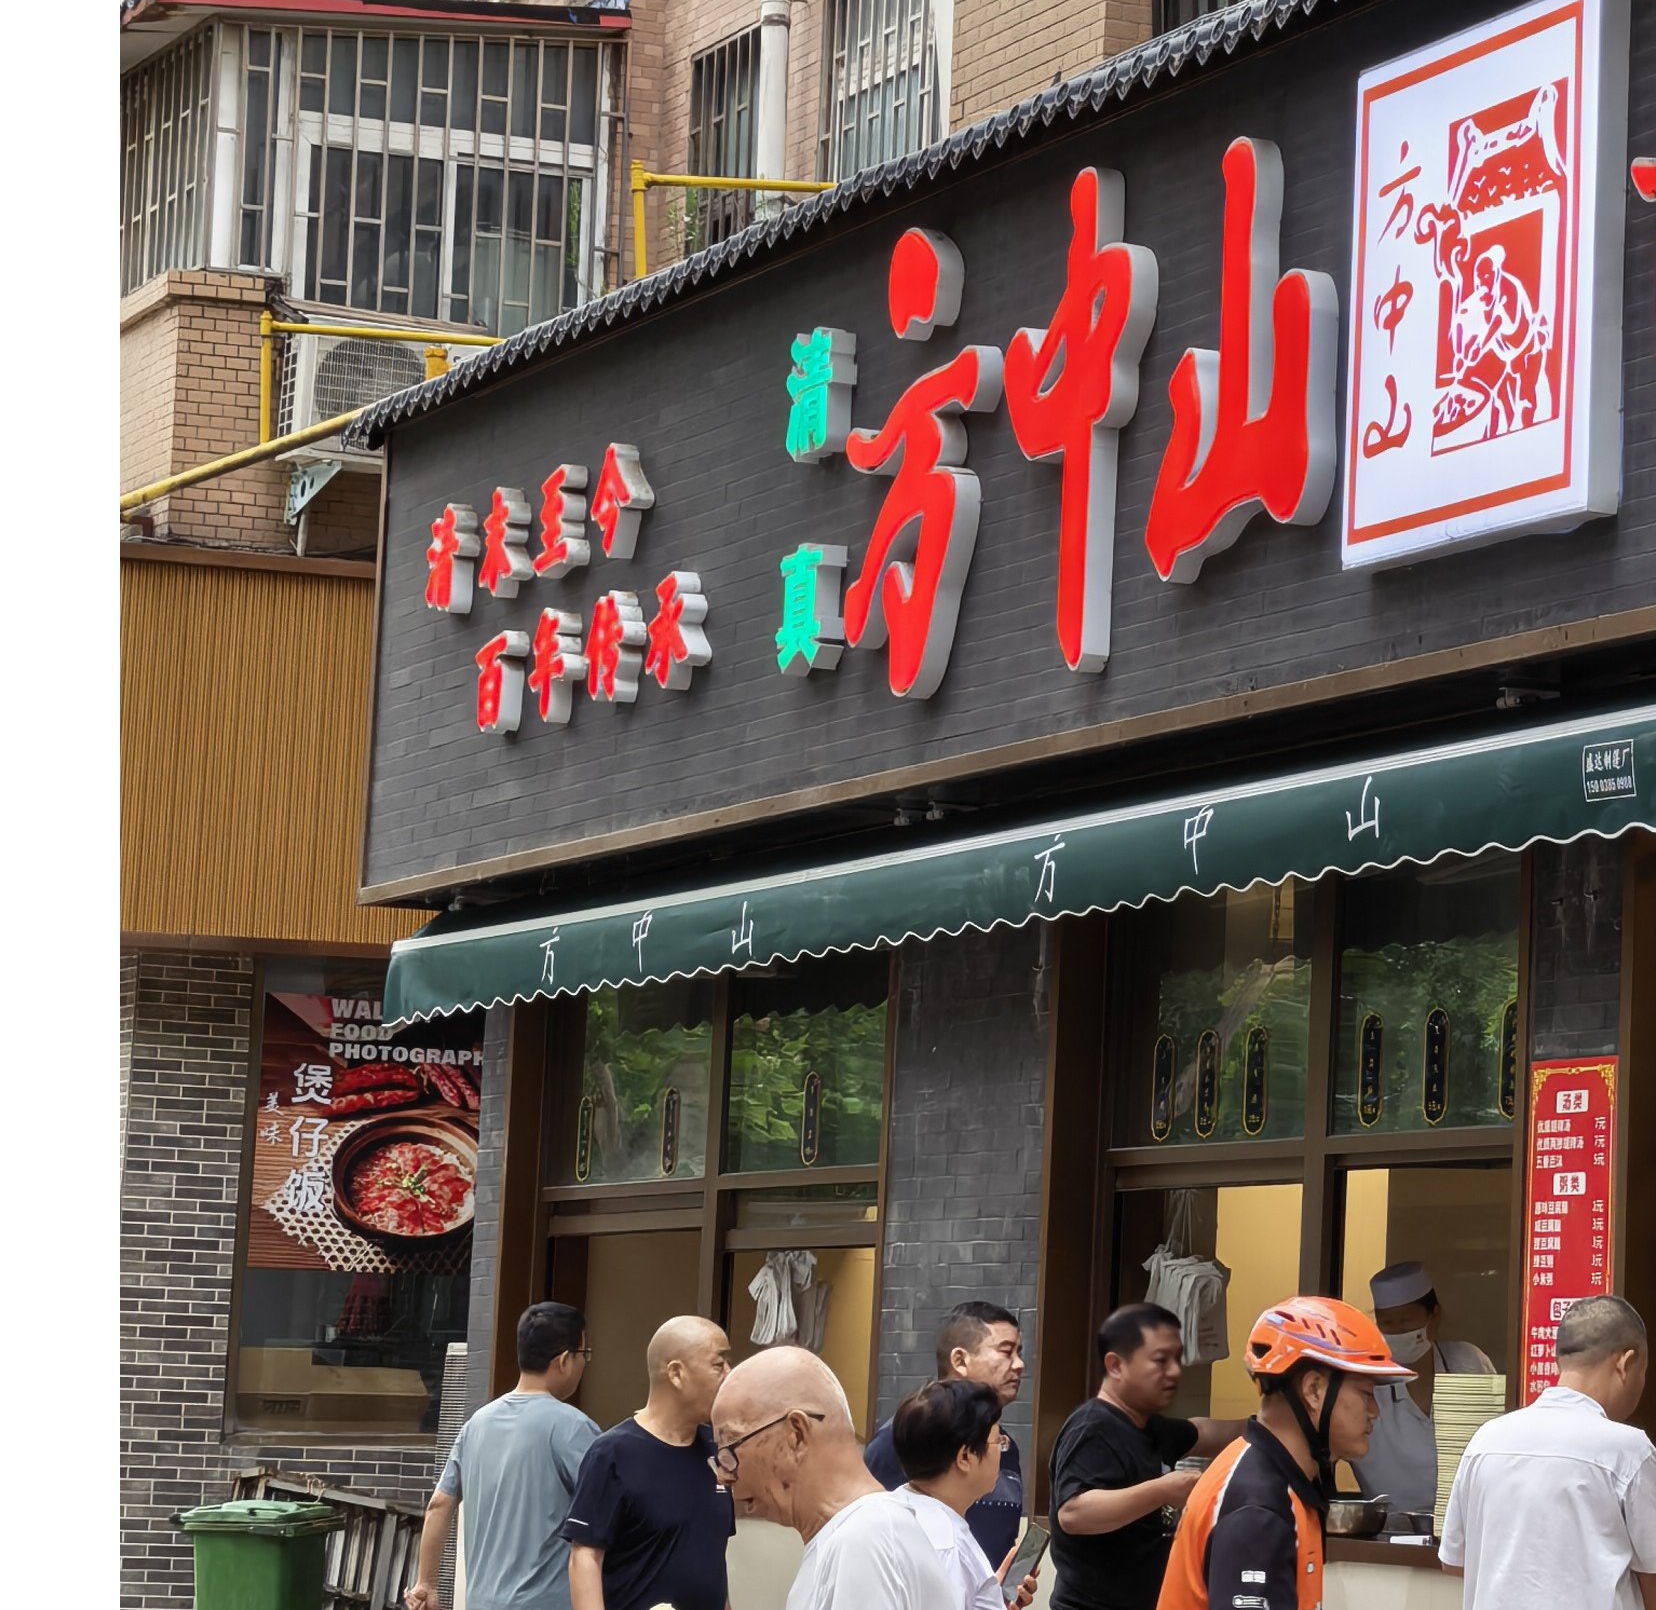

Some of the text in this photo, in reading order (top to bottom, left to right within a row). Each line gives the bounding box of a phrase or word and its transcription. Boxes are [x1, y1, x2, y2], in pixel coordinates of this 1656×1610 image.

[844, 137, 1324, 696] 方中山
[1363, 140, 1422, 460] 方中山
[776, 327, 846, 675] 清真
[540, 776, 1381, 985] 方中山 方中山
[260, 1091, 285, 1146] 美味
[284, 1062, 334, 1212] 煲仔饭
